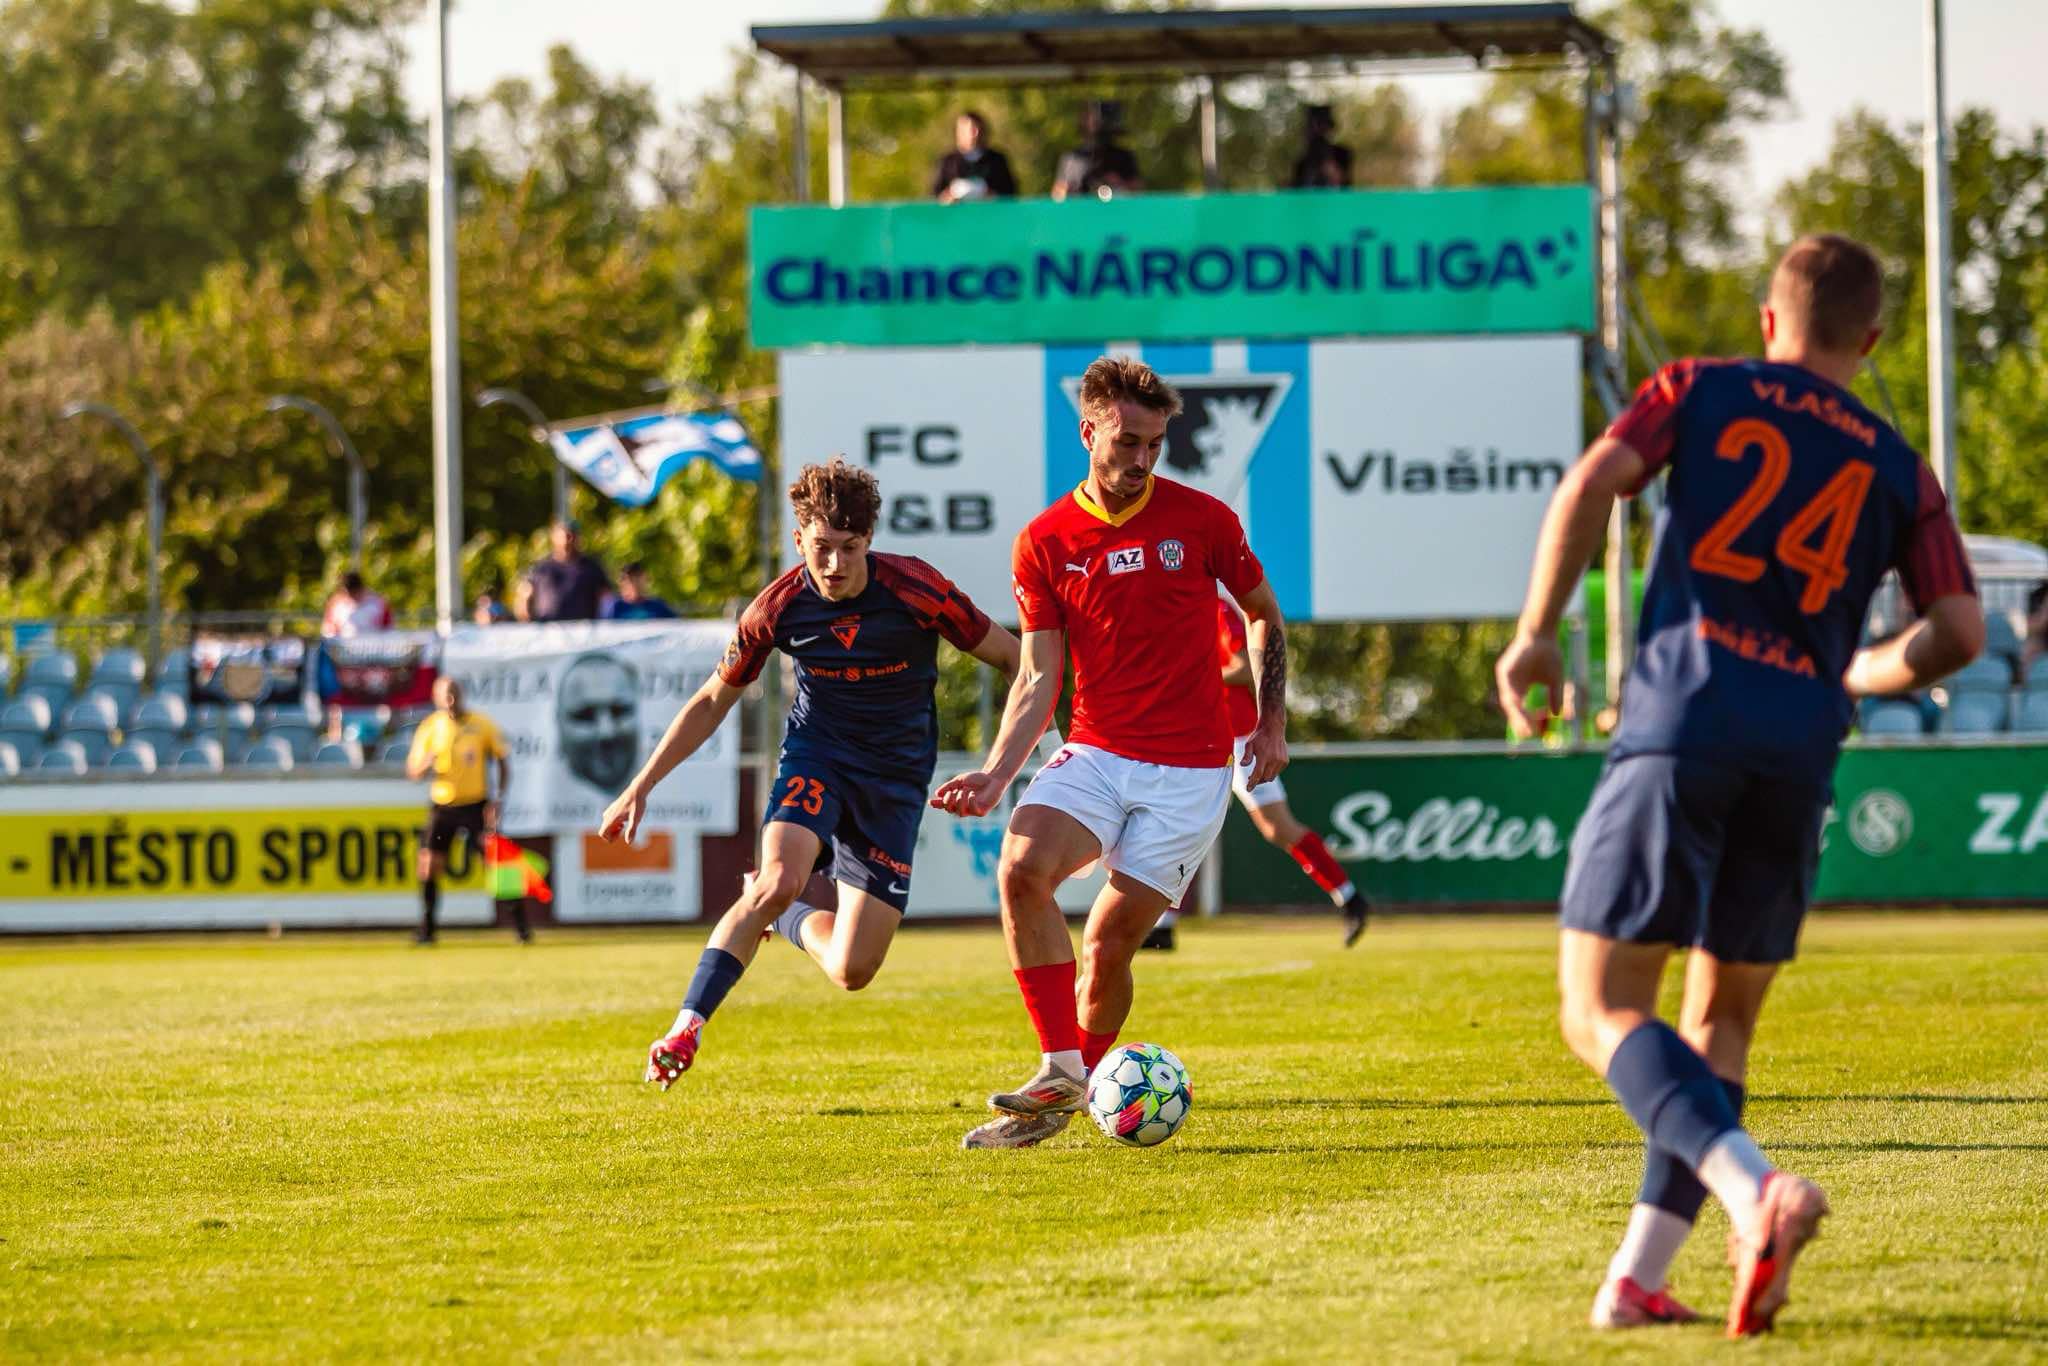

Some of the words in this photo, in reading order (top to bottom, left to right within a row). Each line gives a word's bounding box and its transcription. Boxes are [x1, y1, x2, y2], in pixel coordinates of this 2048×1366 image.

[764, 253, 1022, 306] Chance
[1034, 230, 1377, 297] NÁRODNÍ
[1380, 237, 1538, 293] LIGA
[866, 426, 961, 466] FC
[1325, 447, 1567, 494] Vlašim
[880, 493, 997, 536] &B
[1690, 417, 1877, 615] 24
[1114, 551, 1141, 568] AZ
[780, 776, 824, 816] 23
[1324, 789, 1562, 862] Sellier
[49, 816, 239, 889] MĚSTO
